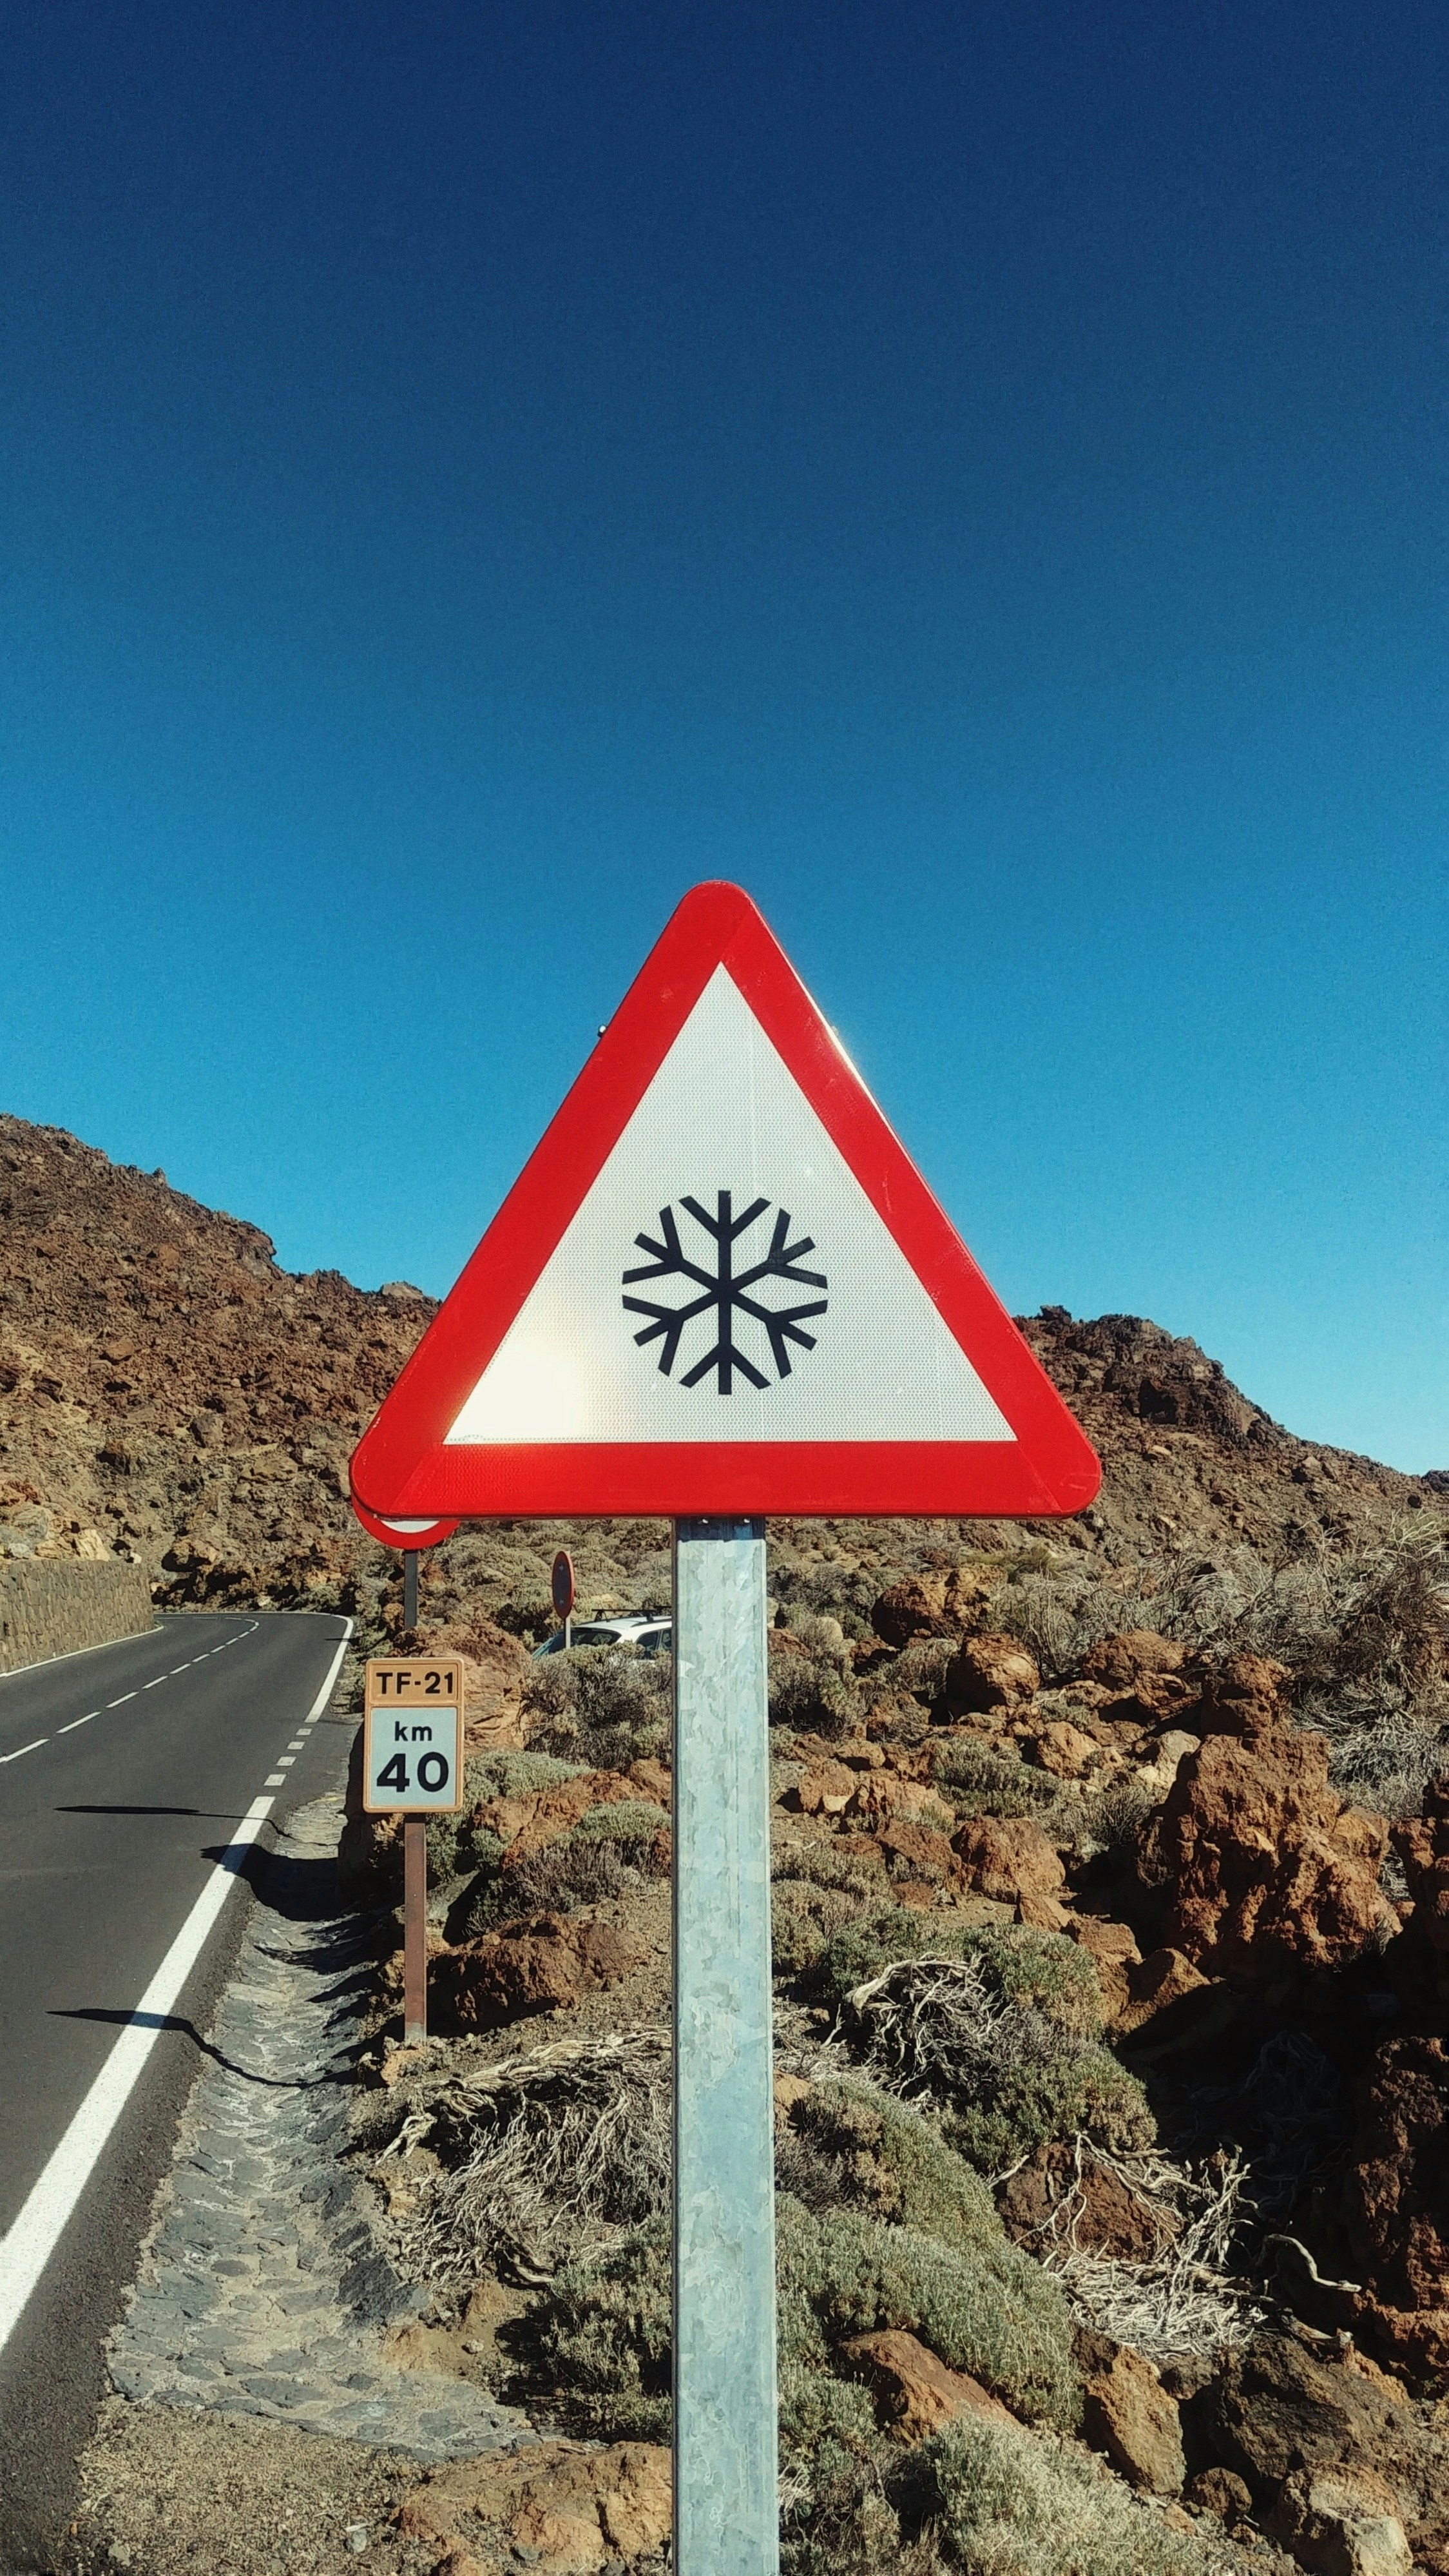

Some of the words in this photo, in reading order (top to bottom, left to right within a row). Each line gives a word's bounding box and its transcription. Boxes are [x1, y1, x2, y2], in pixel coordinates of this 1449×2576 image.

[376, 1671, 453, 1694] TF-21
[394, 1721, 432, 1741] km
[376, 1751, 449, 1792] 40
